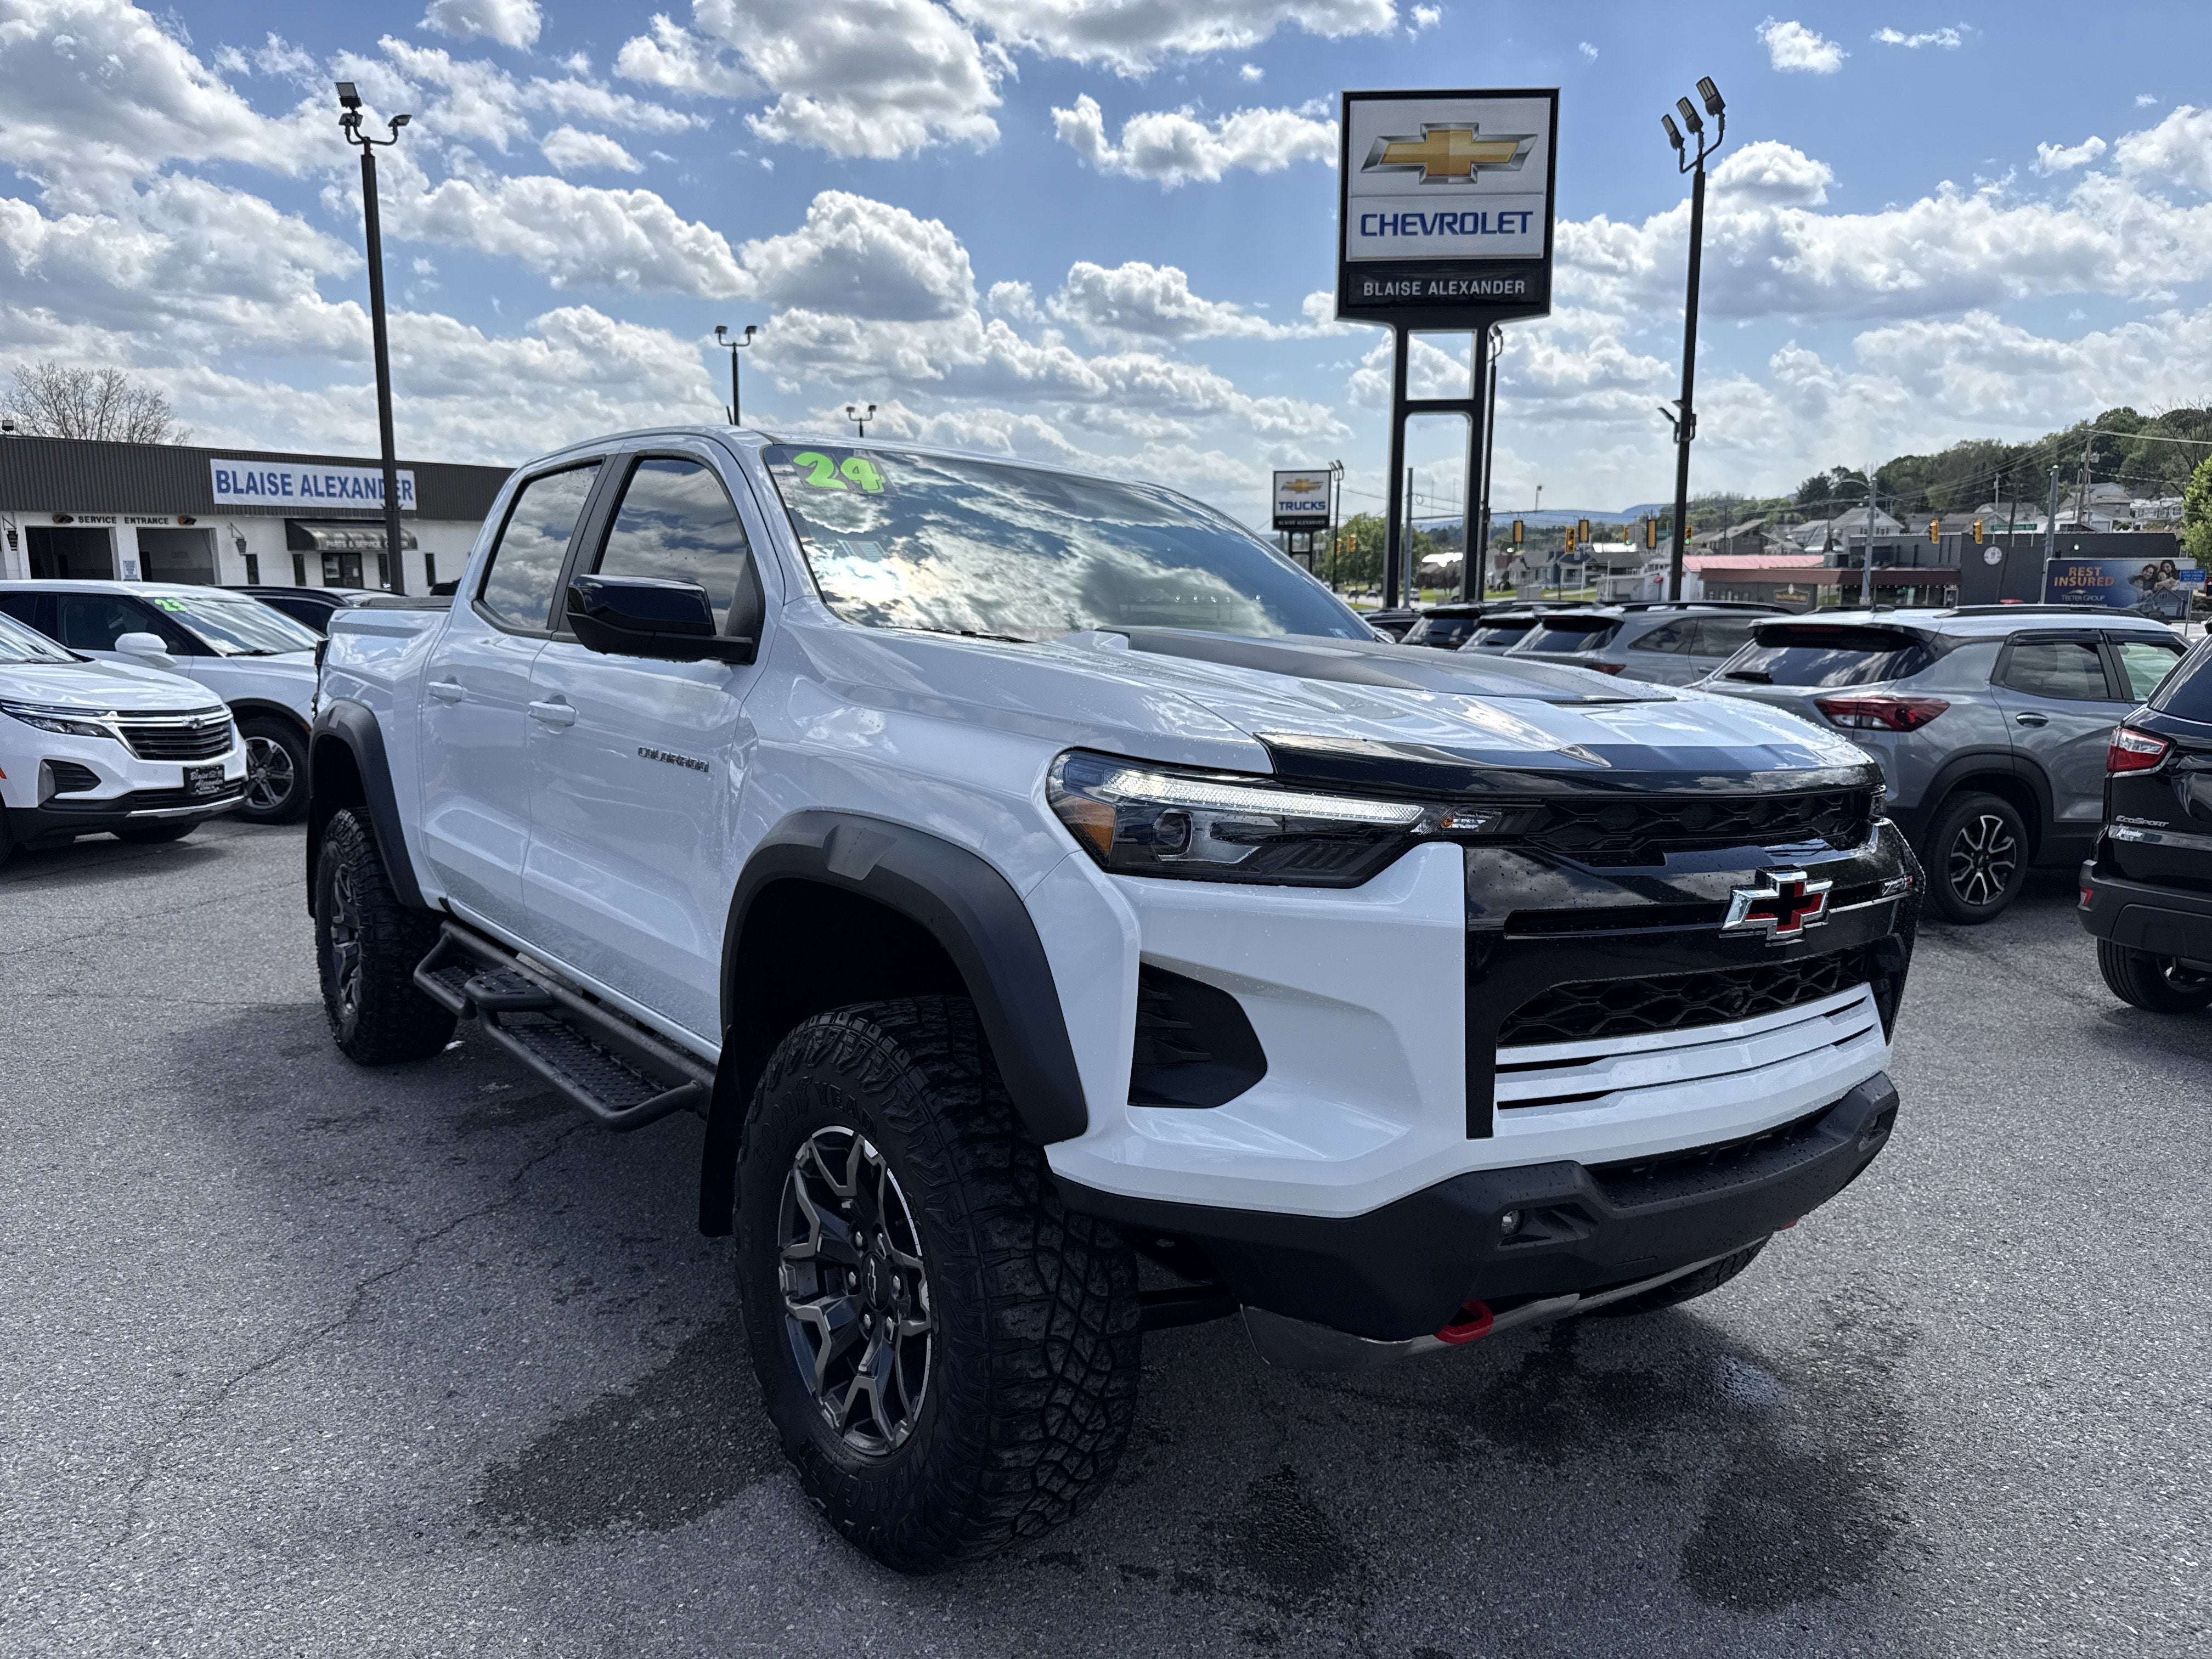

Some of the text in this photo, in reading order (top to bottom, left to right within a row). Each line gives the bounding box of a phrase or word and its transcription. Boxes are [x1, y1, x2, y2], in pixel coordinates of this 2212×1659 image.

[1360, 211, 1533, 236] CHEVROLET
[1363, 280, 1525, 296] BLAISE ALEXANDER
[793, 452, 886, 494] 24
[216, 470, 294, 496] BLAISE
[1278, 501, 1326, 511] TRUCKS
[78, 516, 169, 525] SERVICE ENTRANCE
[2068, 566, 2102, 577] REST
[2053, 576, 2115, 587] INSURED
